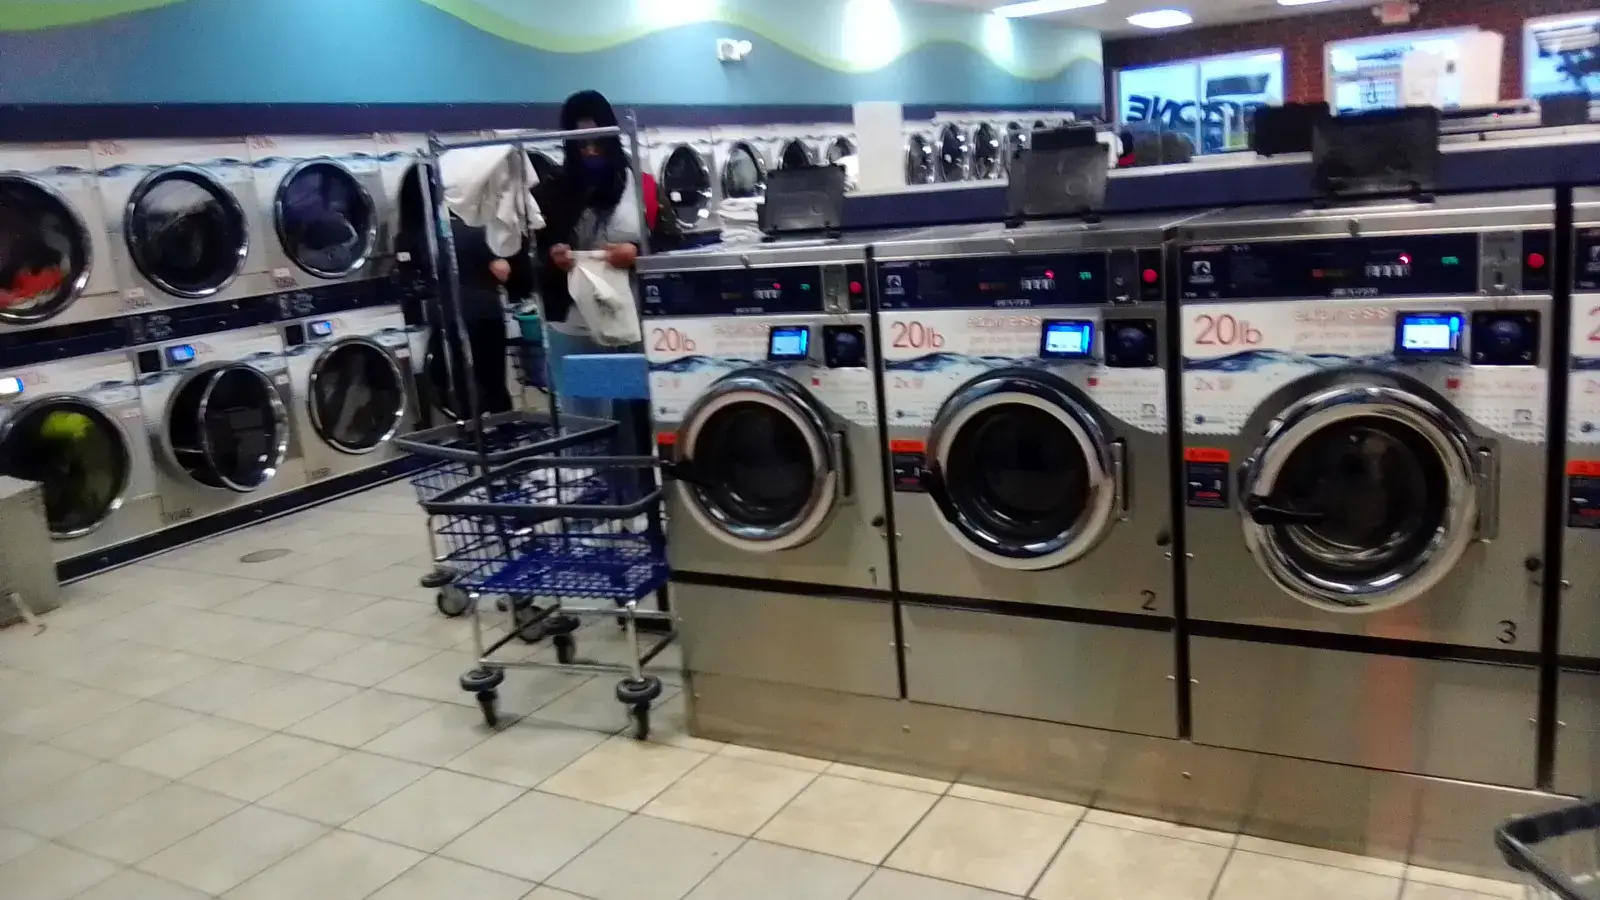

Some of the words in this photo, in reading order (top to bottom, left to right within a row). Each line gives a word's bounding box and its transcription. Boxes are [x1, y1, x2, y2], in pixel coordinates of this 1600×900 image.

[651, 327, 697, 352] 20lb
[891, 321, 945, 349] 20lb
[1194, 313, 1263, 346] 20lb
[868, 565, 877, 585] 1
[1140, 589, 1157, 611] 2
[1497, 620, 1517, 644] 3
